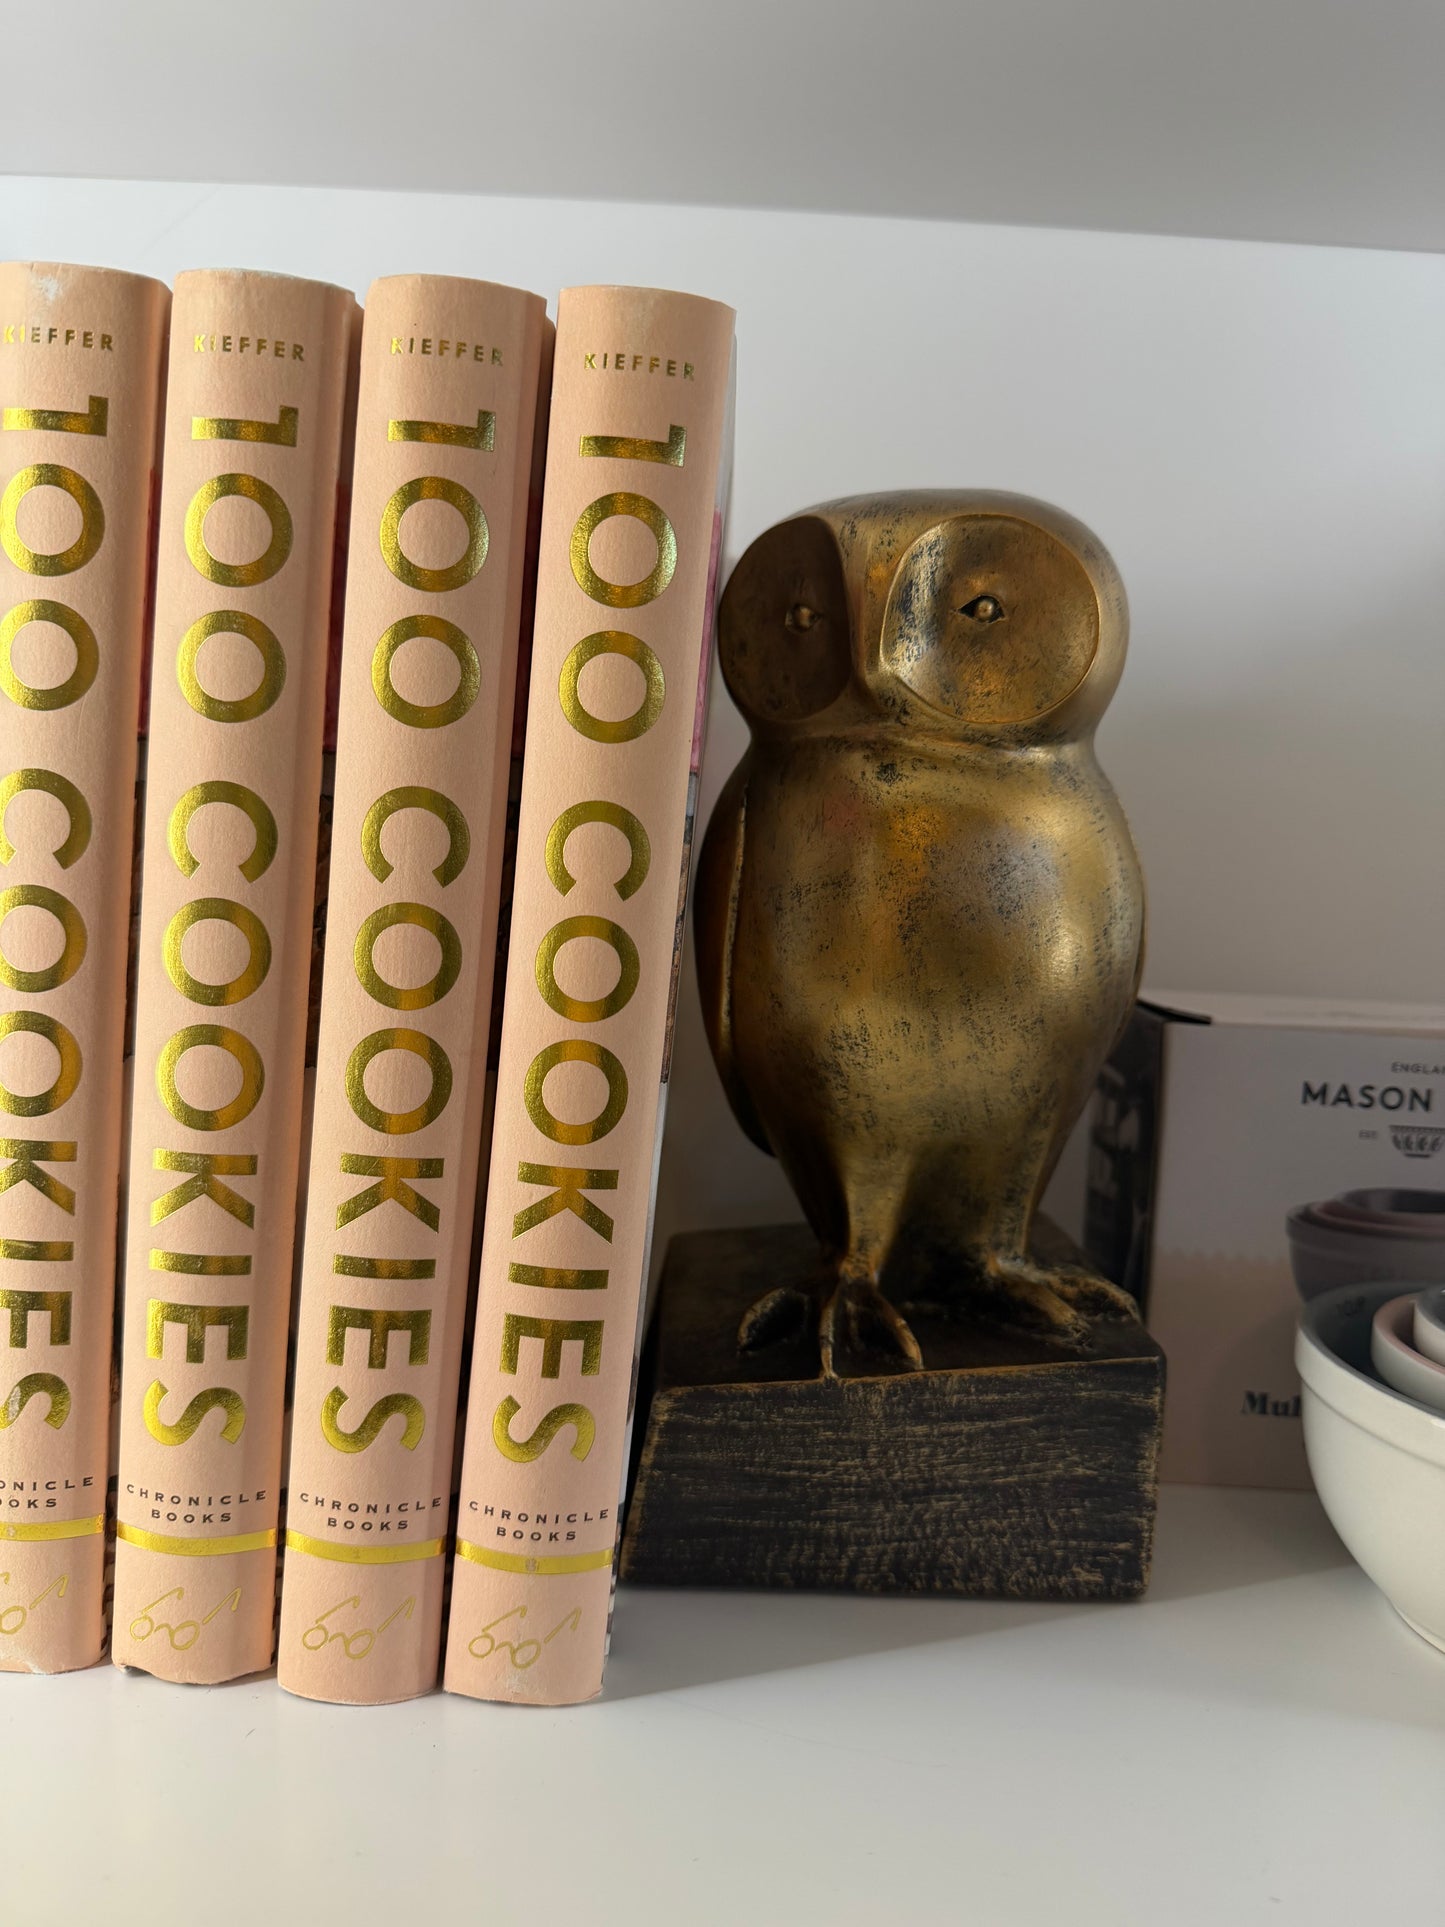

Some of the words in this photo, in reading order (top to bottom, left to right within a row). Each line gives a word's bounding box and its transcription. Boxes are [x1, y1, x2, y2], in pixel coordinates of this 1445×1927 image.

[4, 324, 113, 351] KIEFFER
[194, 334, 305, 362] KIEFFER
[391, 337, 504, 366] KIEFFER
[584, 353, 695, 381] KIEFFER
[0, 394, 109, 711] 100
[176, 405, 299, 724] 100
[371, 409, 496, 730] 100
[558, 424, 688, 744] 100
[1391, 1061, 1445, 1075] ENGLA
[0, 768, 92, 1430] COOKIES
[1302, 1080, 1432, 1113] MASON
[143, 780, 278, 1447] COOKIES
[320, 786, 471, 1454] COOKIES
[491, 800, 652, 1464] COOKIES
[0, 1498, 57, 1509] OKS
[126, 1483, 267, 1506] CHRONICLE
[300, 1491, 442, 1514] CHRONICLE
[151, 1508, 232, 1524] BOOKS
[327, 1516, 409, 1532] BOOKS
[468, 1500, 610, 1525] CHRONICLE
[496, 1526, 577, 1542] BOOKS
